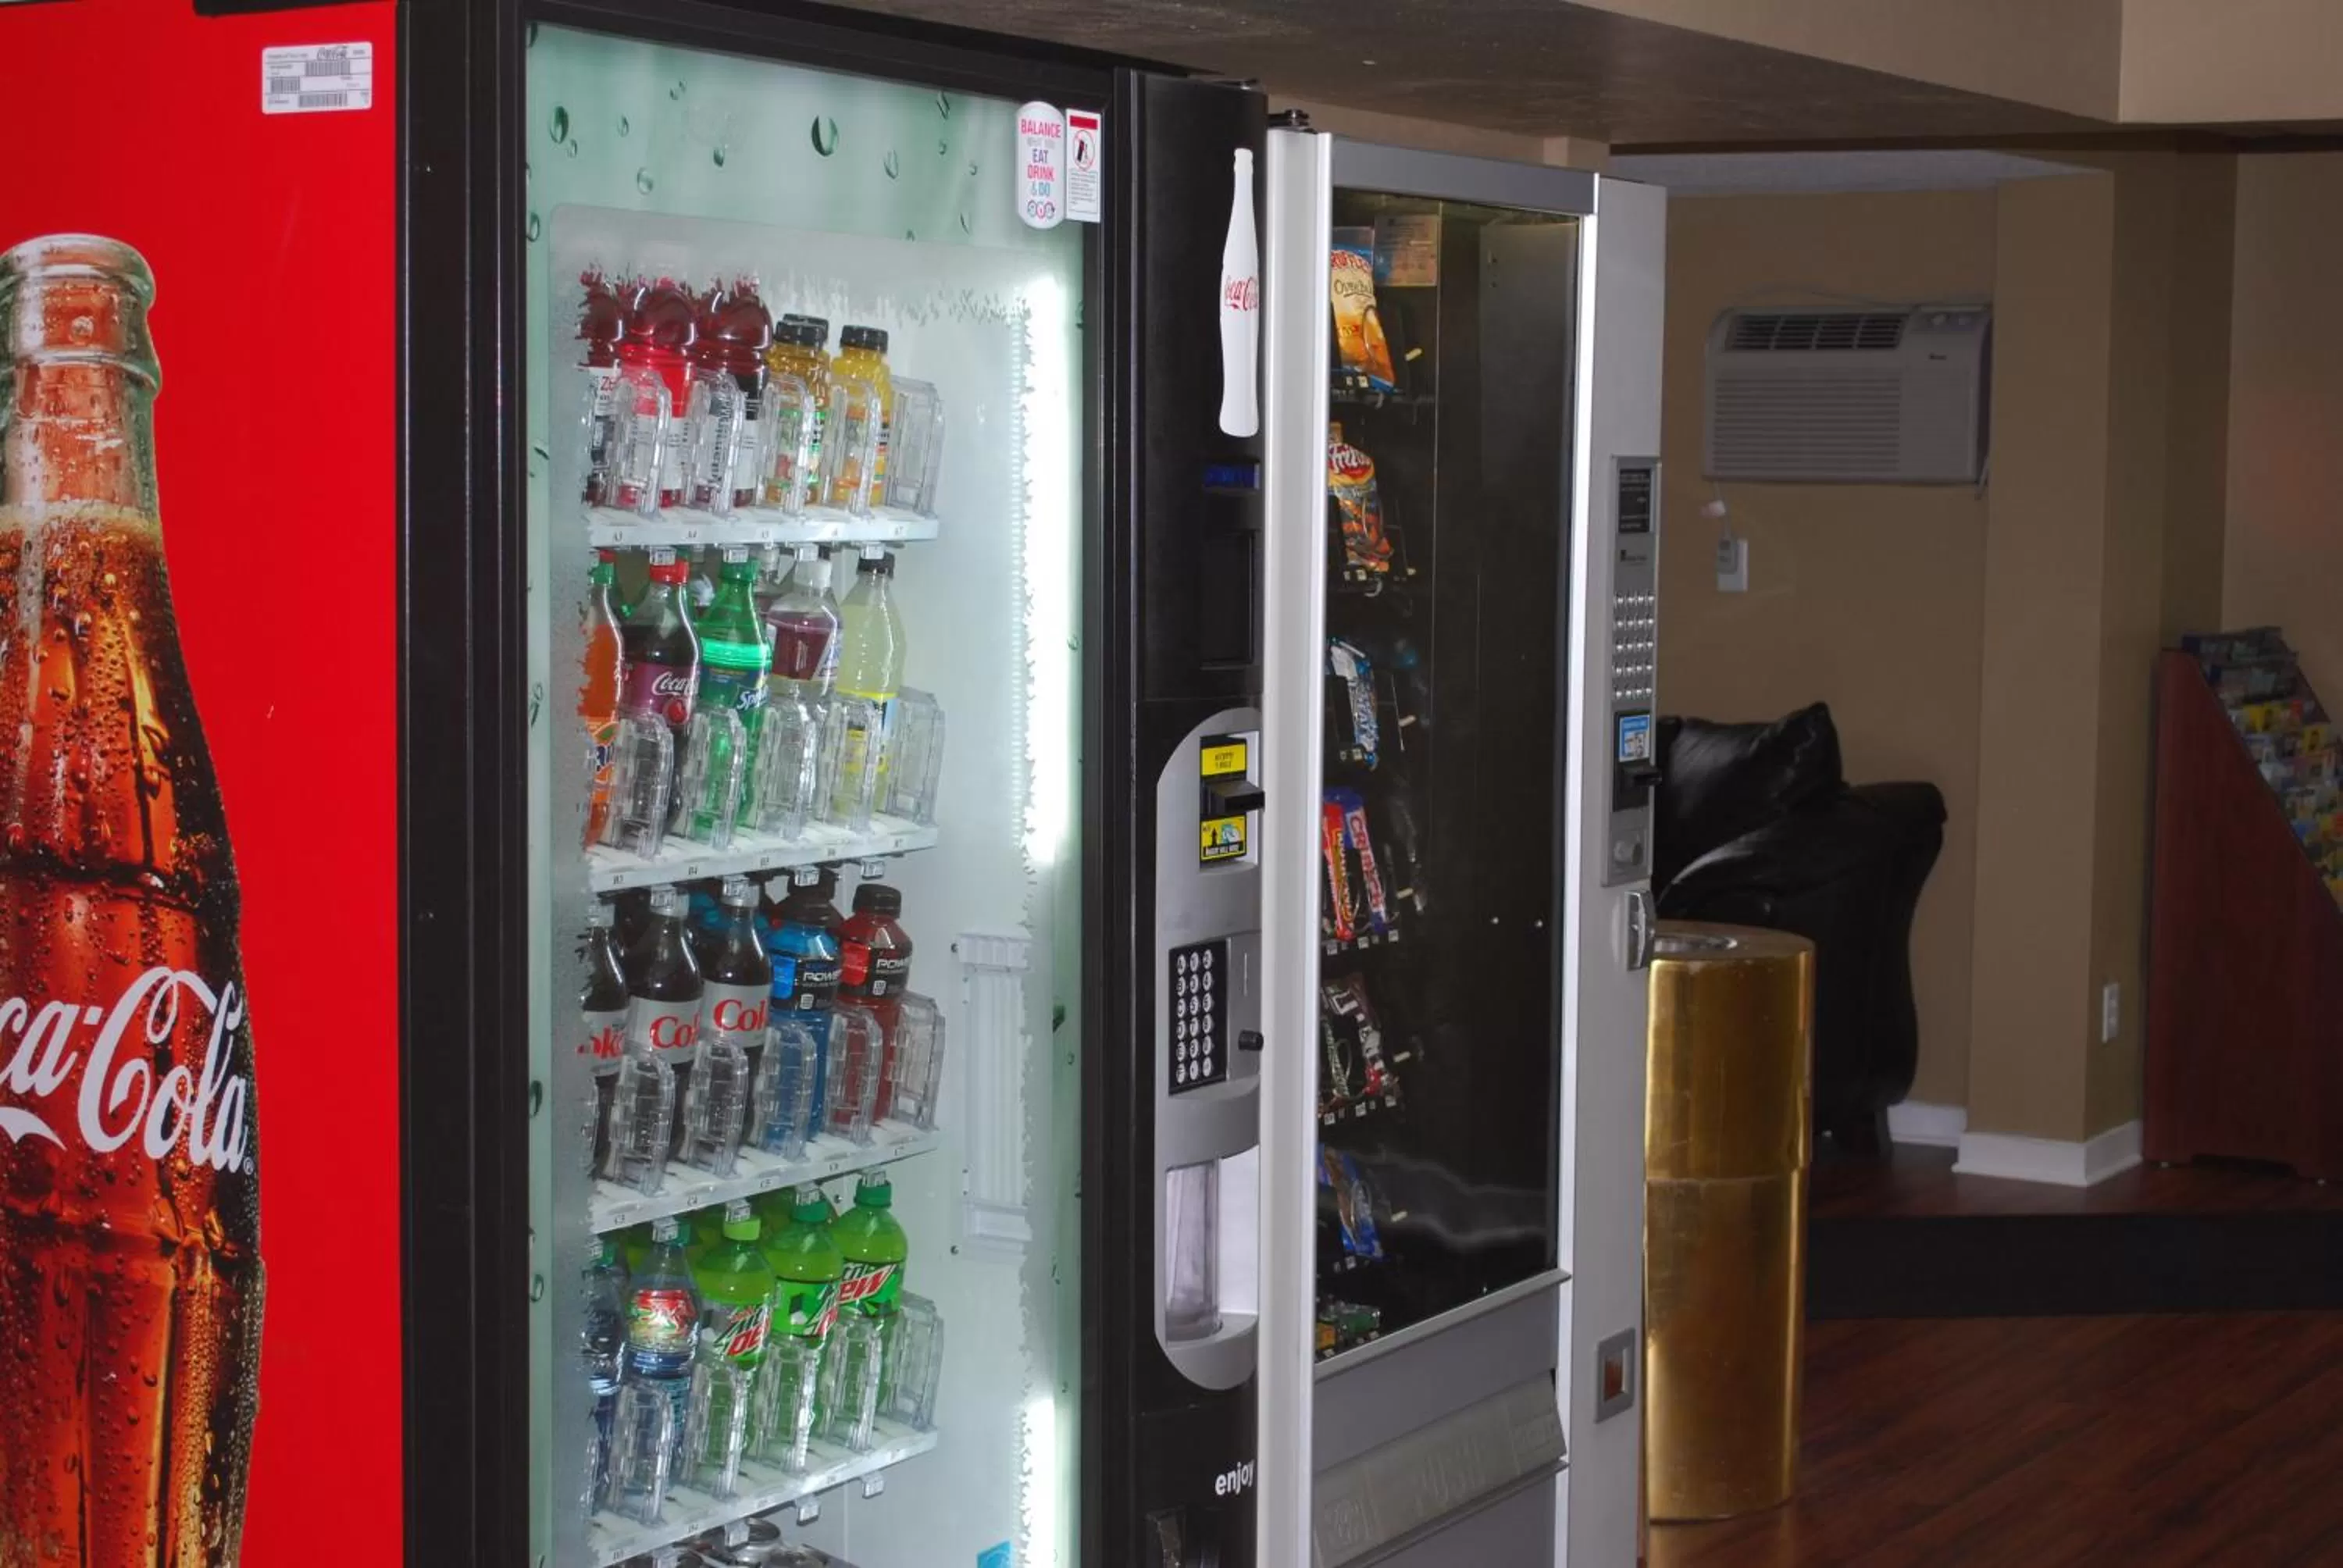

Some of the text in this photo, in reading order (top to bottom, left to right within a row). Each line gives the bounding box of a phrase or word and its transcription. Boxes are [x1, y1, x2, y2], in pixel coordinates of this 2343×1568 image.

[1020, 118, 1061, 138] BALANCE
[1032, 148, 1049, 164] EAT
[1027, 164, 1054, 182] DRINK
[0, 966, 250, 1173] ca-Cola
[1214, 1459, 1256, 1496] enjoy
